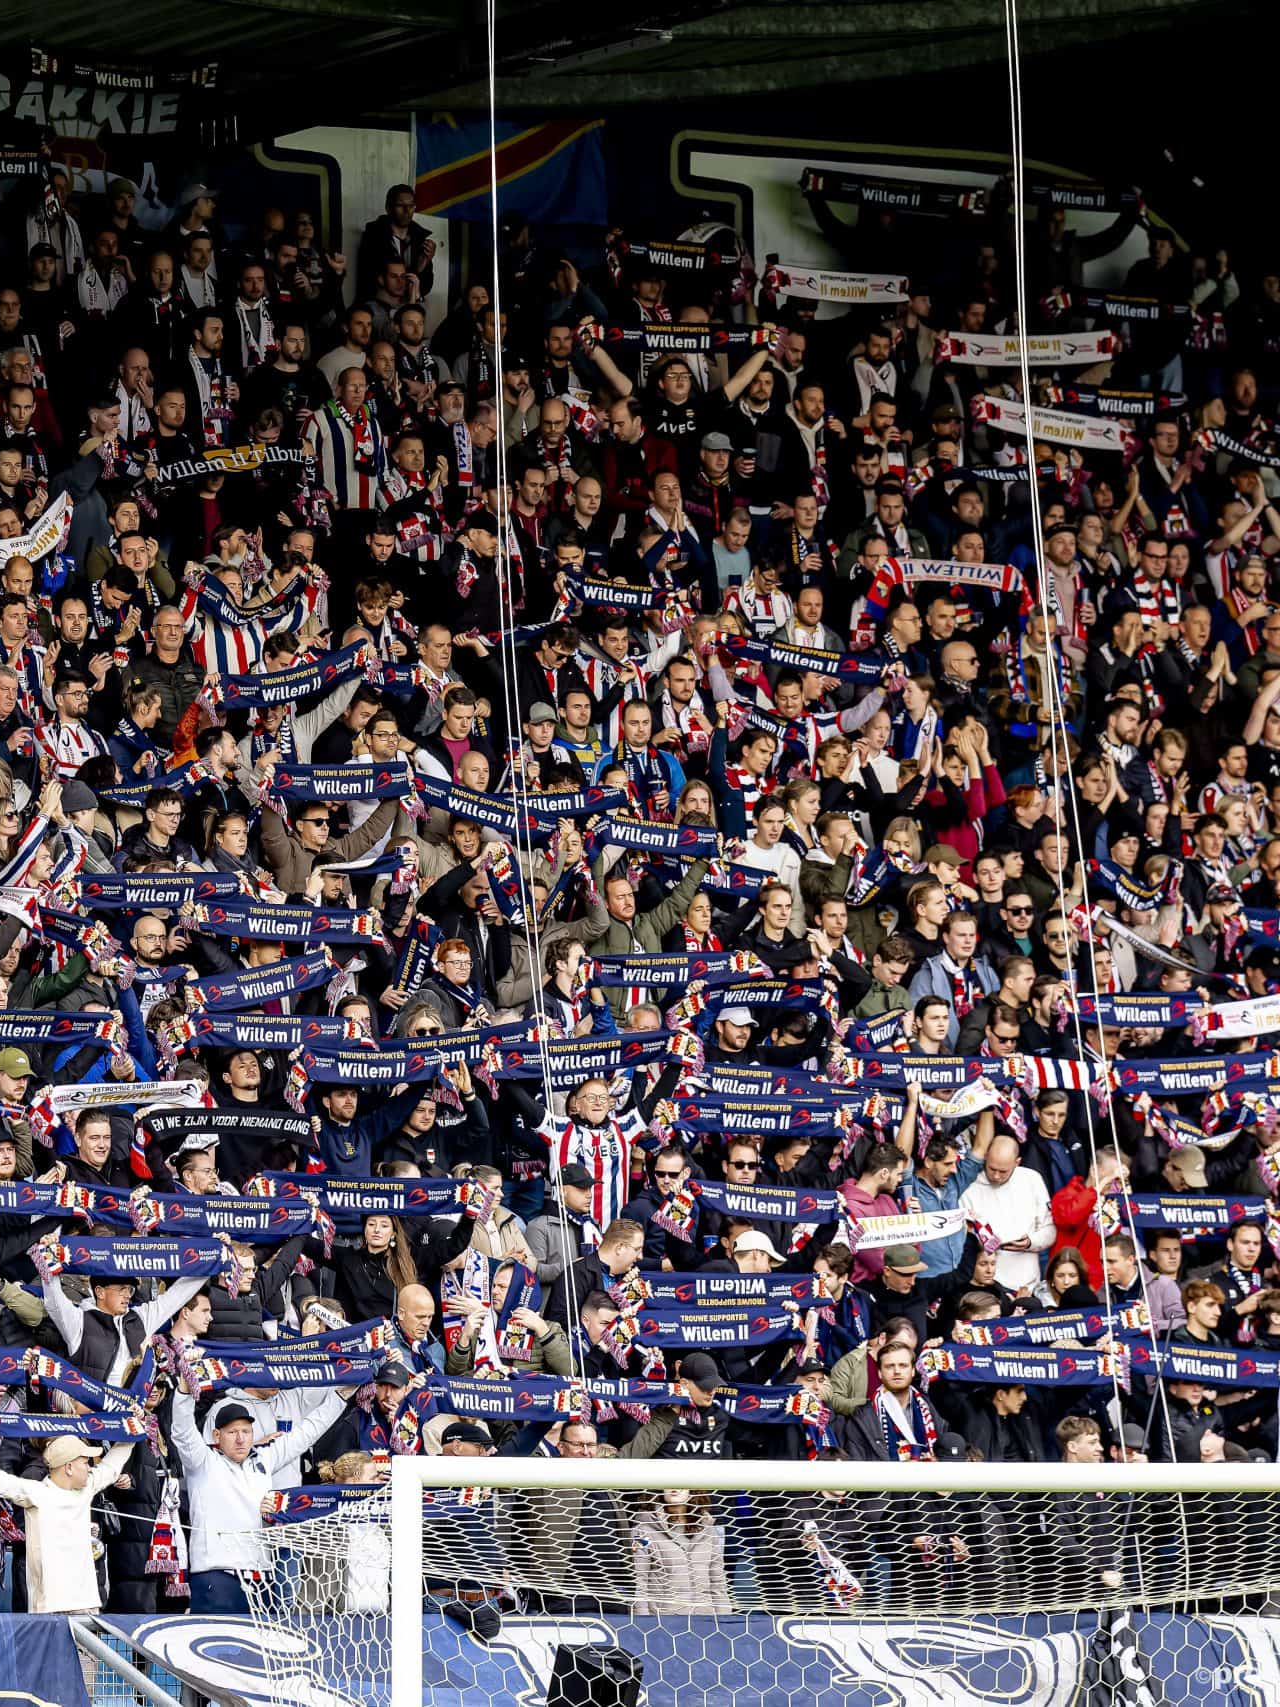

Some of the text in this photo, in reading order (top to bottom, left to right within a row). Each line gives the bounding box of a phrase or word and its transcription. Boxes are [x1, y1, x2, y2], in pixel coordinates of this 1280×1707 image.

[96, 72, 141, 87] Willem
[649, 251, 692, 268] Willem
[1106, 303, 1148, 318] Willem
[646, 334, 697, 348] Willem
[1098, 398, 1142, 413] Willem
[157, 459, 226, 483] Willem
[922, 562, 1001, 582] WILLEM
[584, 585, 639, 603] Willem
[770, 650, 823, 673] Willem
[261, 686, 309, 702] Willem
[314, 780, 361, 794] Willem
[448, 796, 502, 823] Willem
[610, 826, 663, 847] Willem
[126, 889, 179, 902] Willem
[248, 918, 297, 935] Willem
[623, 969, 675, 982] Willem
[239, 979, 283, 1000] Willem
[1114, 1007, 1160, 1022] Willem
[236, 1027, 287, 1042] Willem
[550, 1053, 605, 1070] Willem
[338, 1063, 392, 1078] Willem
[904, 1067, 953, 1083] Willem
[712, 1078, 759, 1094] Willem
[166, 1116, 180, 1128] WE
[184, 1116, 208, 1126] ZIJN
[212, 1116, 238, 1127] VOOR
[240, 1117, 281, 1129] NIEMAND
[723, 1113, 776, 1129] Willem
[327, 1192, 388, 1208] Willem
[726, 1195, 781, 1213] Willem
[206, 1212, 256, 1228] Willem
[1162, 1208, 1216, 1222] Willem
[113, 1255, 166, 1270] Willem
[710, 1279, 766, 1294] Willem
[681, 1327, 735, 1341] Willem
[268, 1366, 322, 1380] Willem
[994, 1361, 1046, 1378] Willem
[1172, 1357, 1224, 1377] Willem
[451, 1392, 501, 1412] Willem
